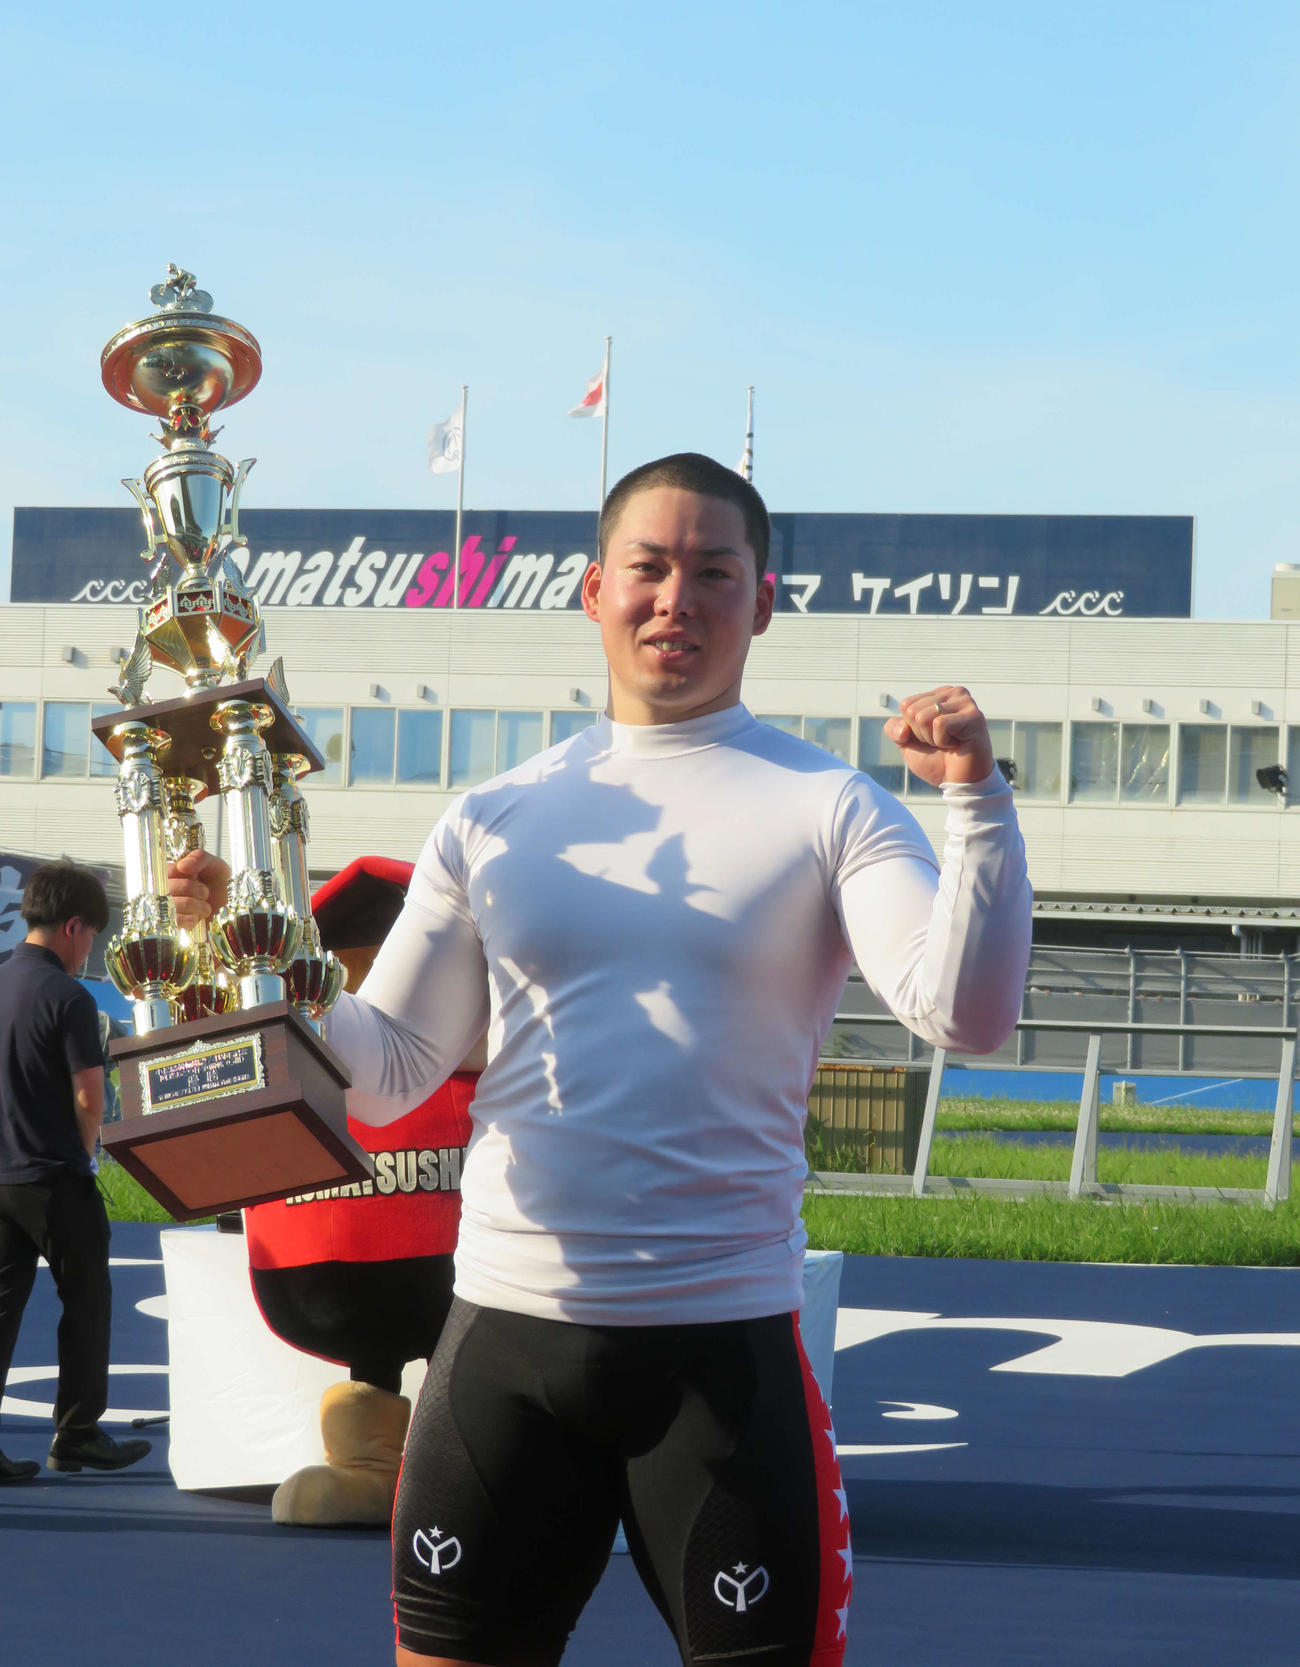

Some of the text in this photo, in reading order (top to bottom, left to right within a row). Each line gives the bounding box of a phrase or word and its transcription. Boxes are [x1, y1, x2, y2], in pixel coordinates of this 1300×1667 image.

[176, 533, 589, 610] omatsushima
[765, 572, 1020, 615] マ ケイリン
